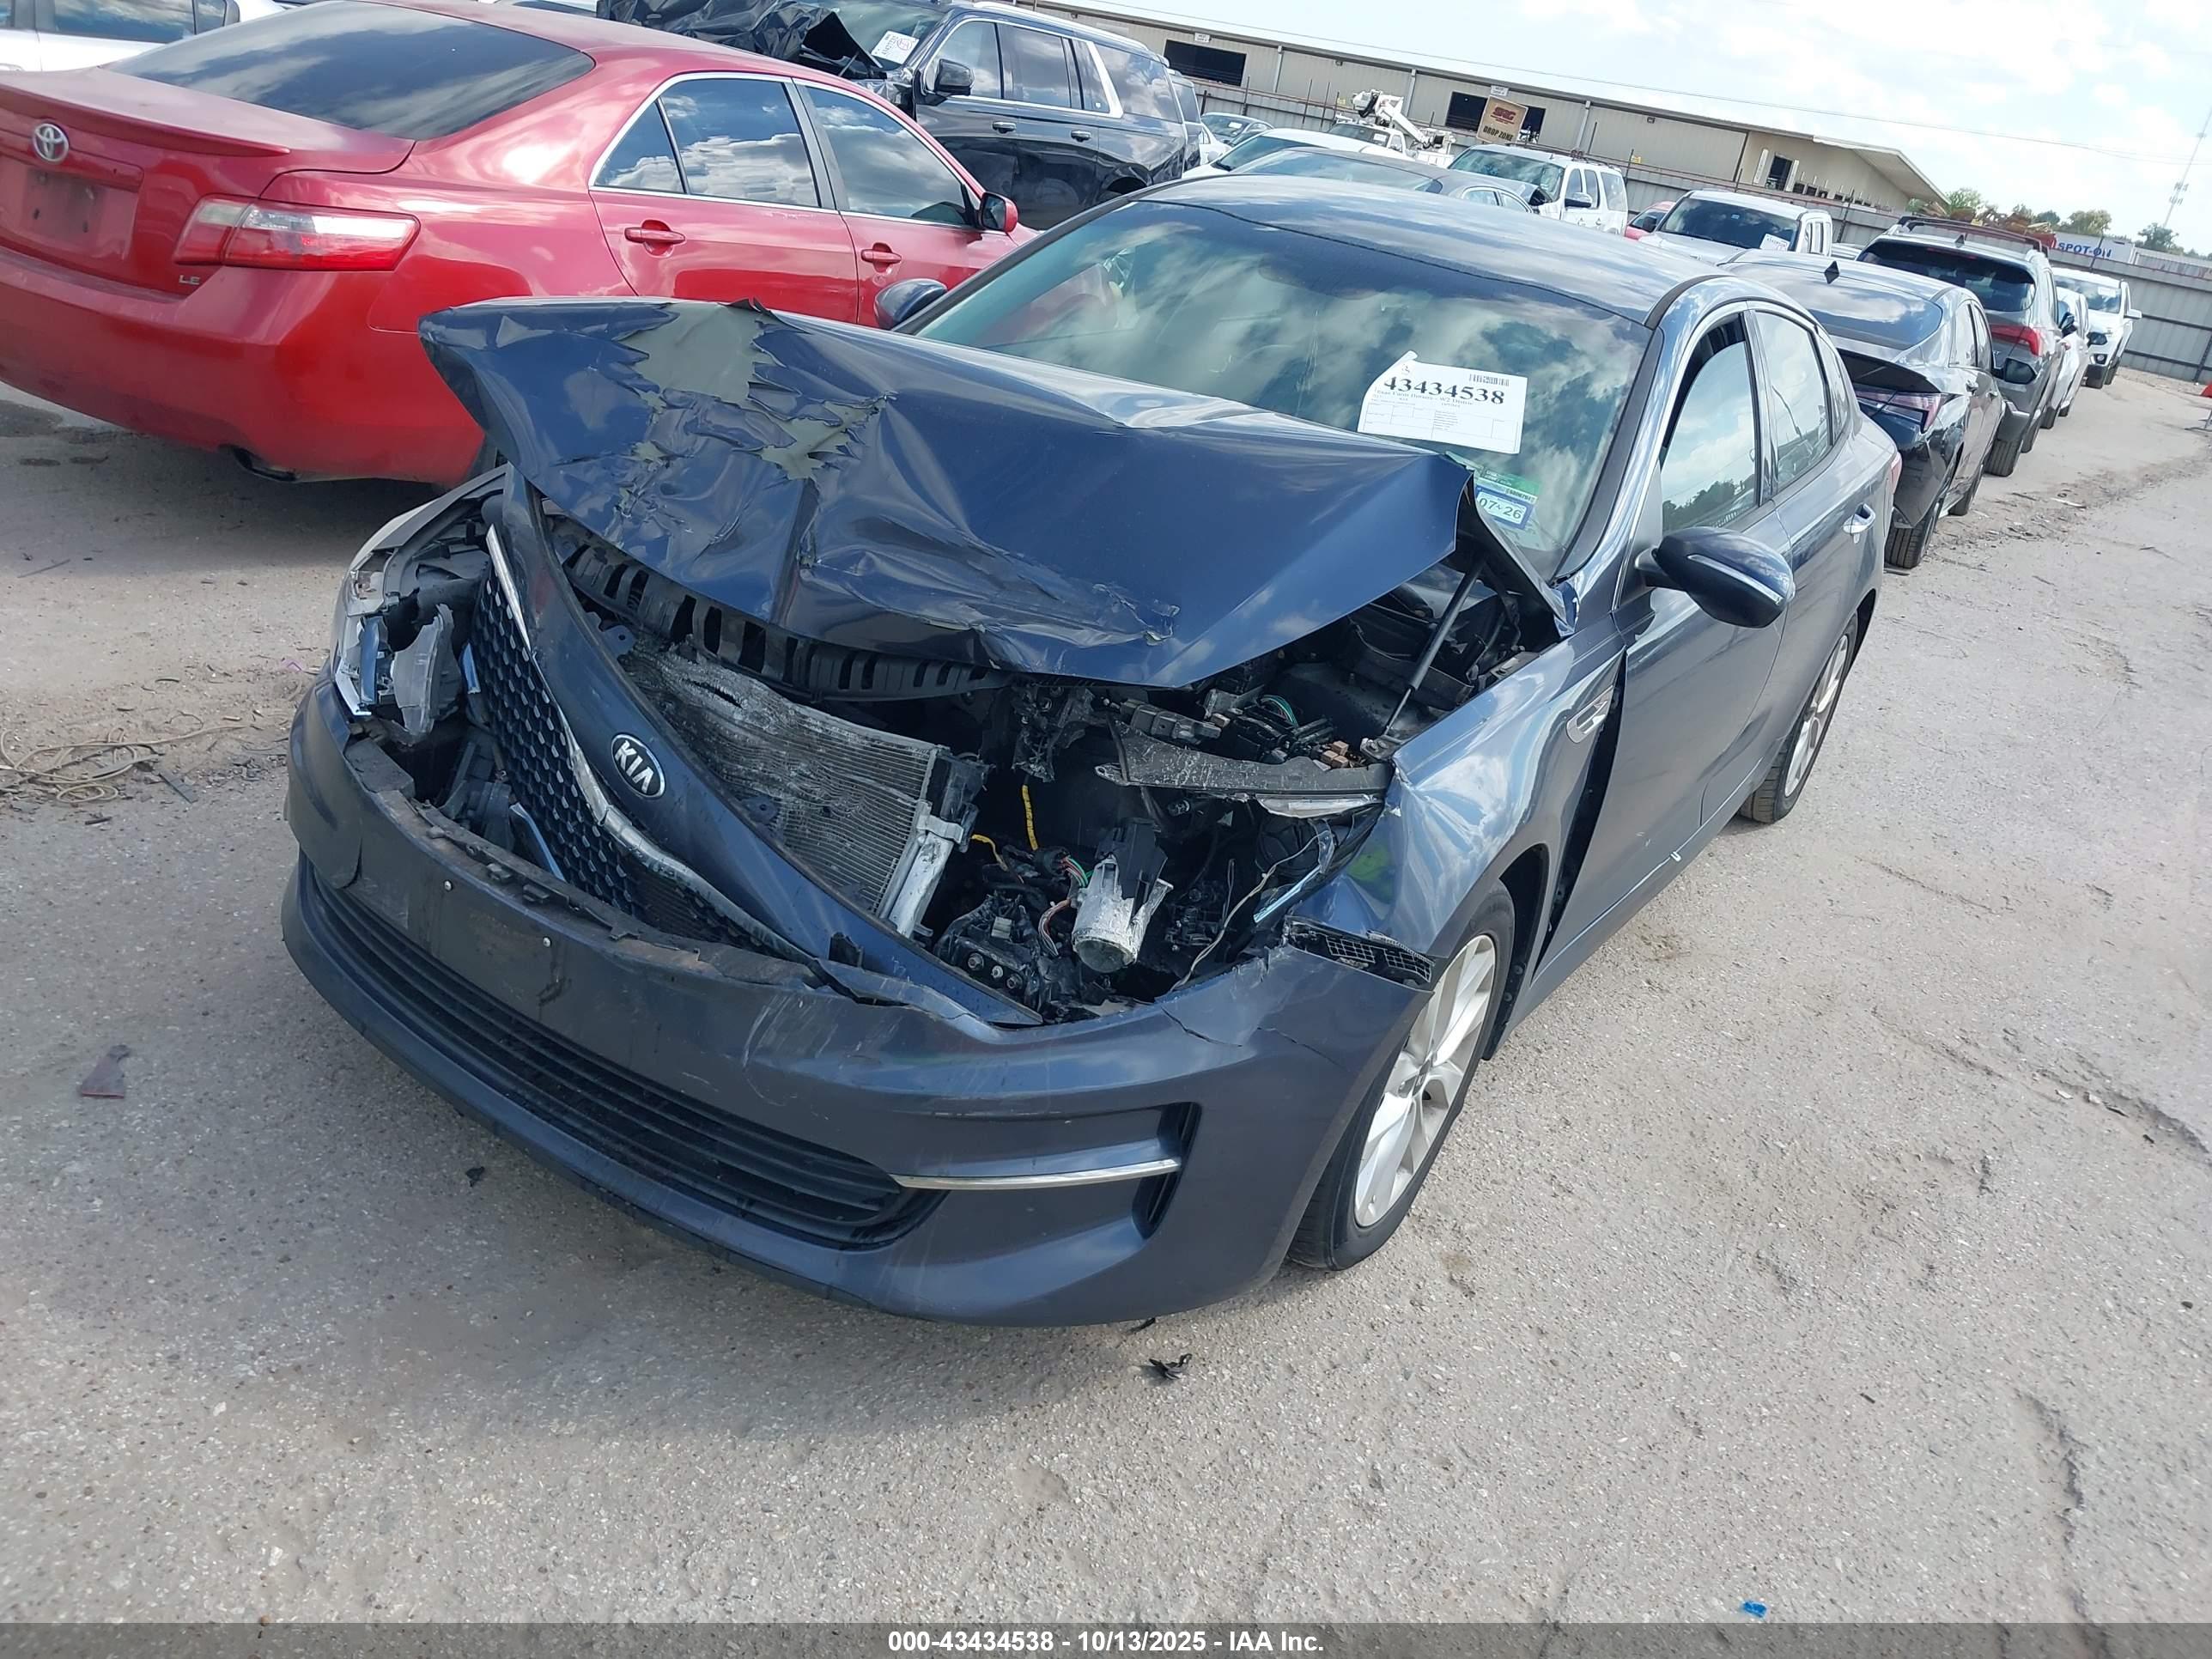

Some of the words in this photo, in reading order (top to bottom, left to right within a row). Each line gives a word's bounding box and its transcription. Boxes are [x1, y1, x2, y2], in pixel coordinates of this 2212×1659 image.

[1483, 125, 1499, 137] DROP
[1498, 131, 1513, 141] ZONE
[2058, 242, 2112, 258] SPOT-ON
[179, 275, 200, 285] LE
[1383, 376, 1504, 404] 43434538
[1480, 497, 1498, 510] 07
[1503, 506, 1522, 520] 26
[614, 739, 654, 793] KIA
